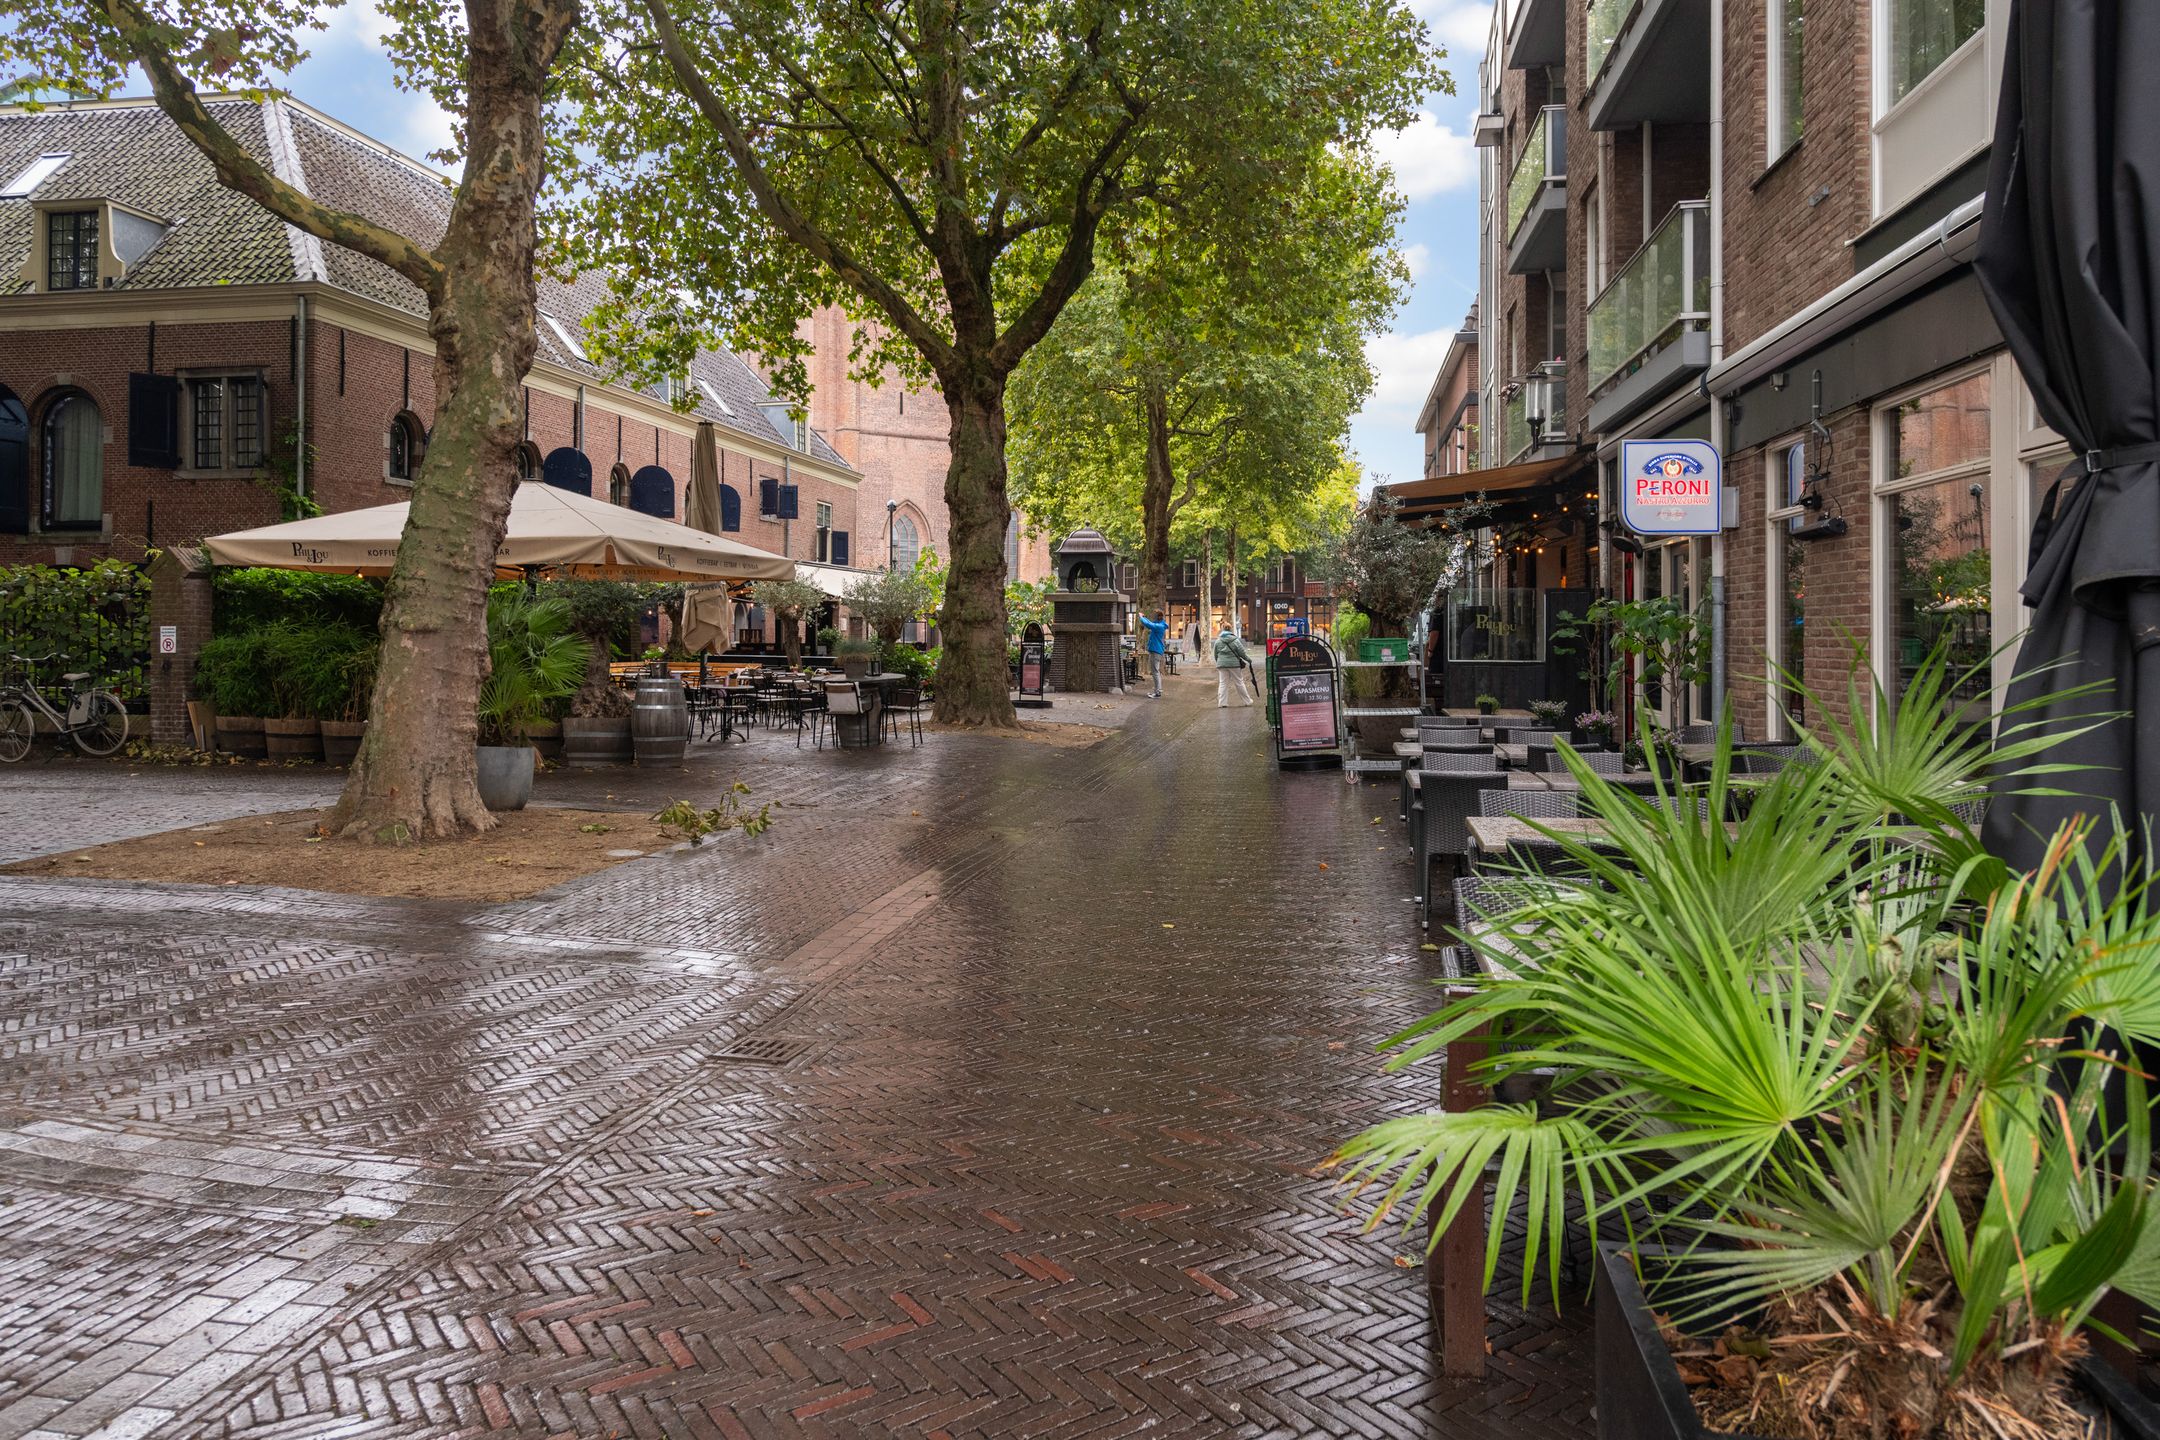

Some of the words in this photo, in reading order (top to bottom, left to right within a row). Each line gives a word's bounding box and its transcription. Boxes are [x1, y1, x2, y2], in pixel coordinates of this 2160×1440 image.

[1636, 479, 1709, 496] PERONI
[1636, 497, 1670, 505] NASTRO
[1672, 497, 1710, 505] AZZURRO
[367, 549, 399, 557] KOFFIE
[1294, 686, 1330, 694] TAPASMENU
